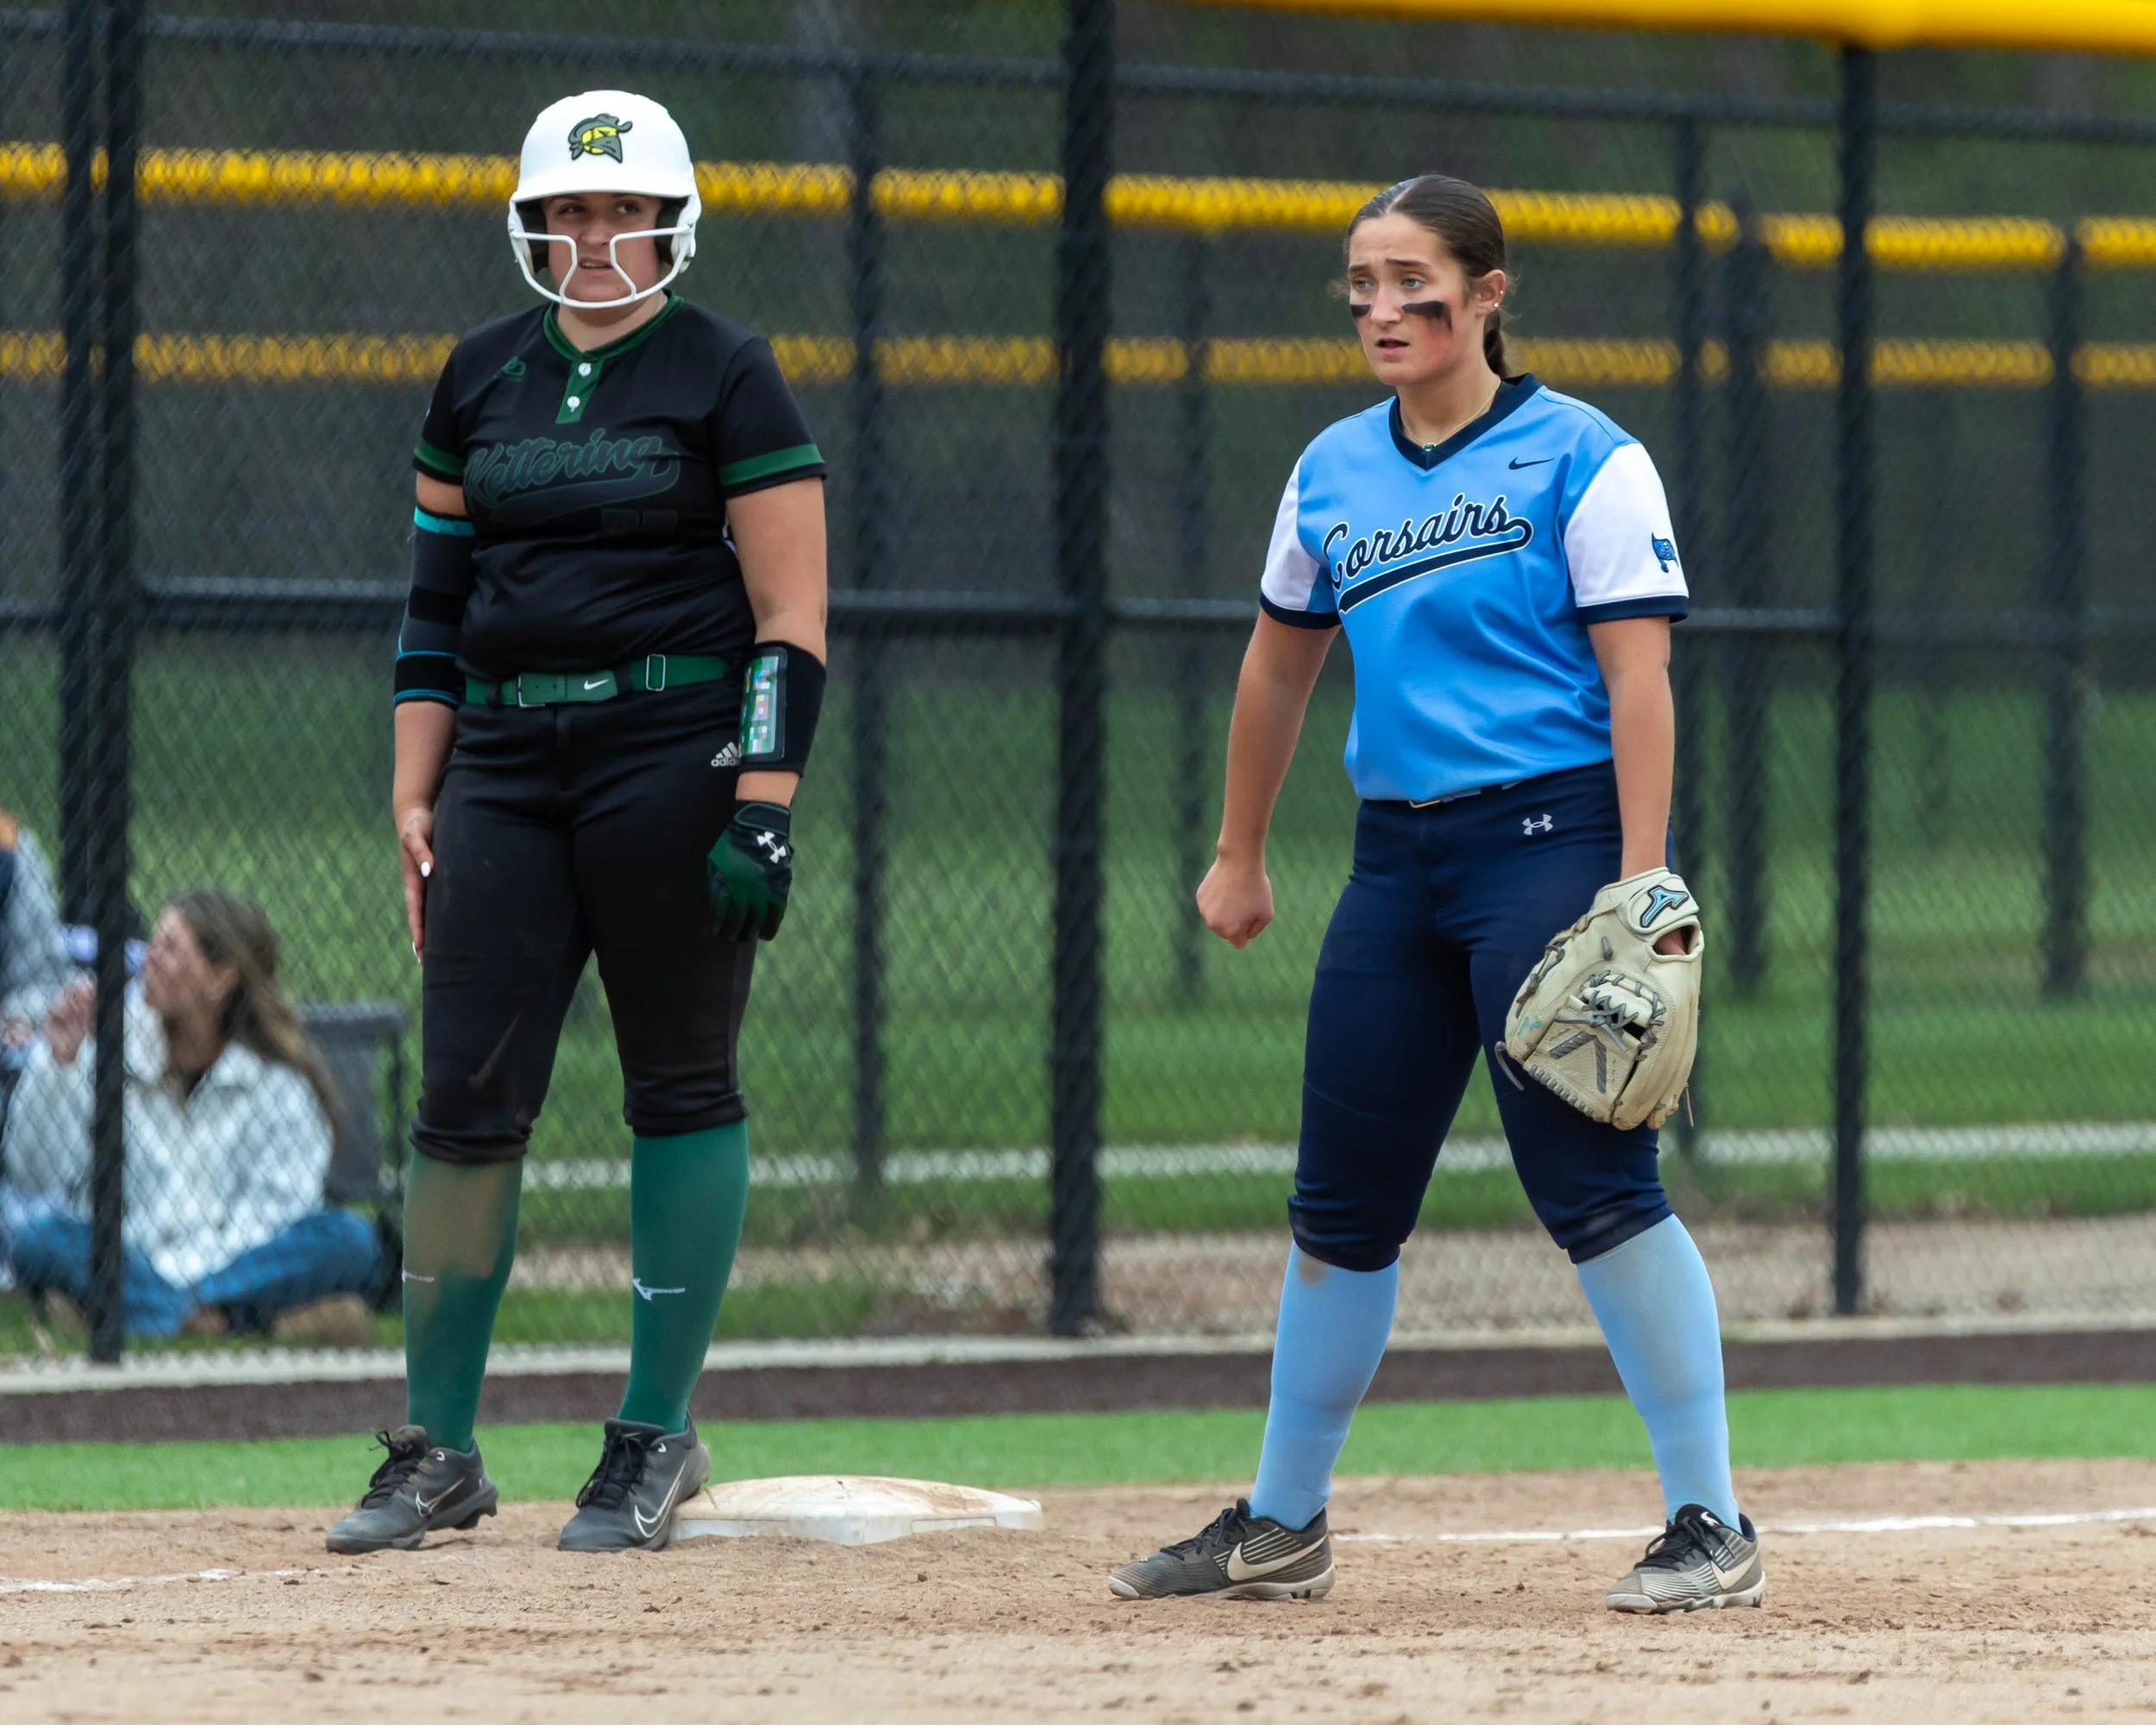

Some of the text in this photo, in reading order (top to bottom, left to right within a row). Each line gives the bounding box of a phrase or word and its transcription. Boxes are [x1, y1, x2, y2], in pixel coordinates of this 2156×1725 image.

[463, 428, 678, 511] Kettering
[1323, 492, 1520, 591] Corsairs
[710, 756, 741, 768] adid
